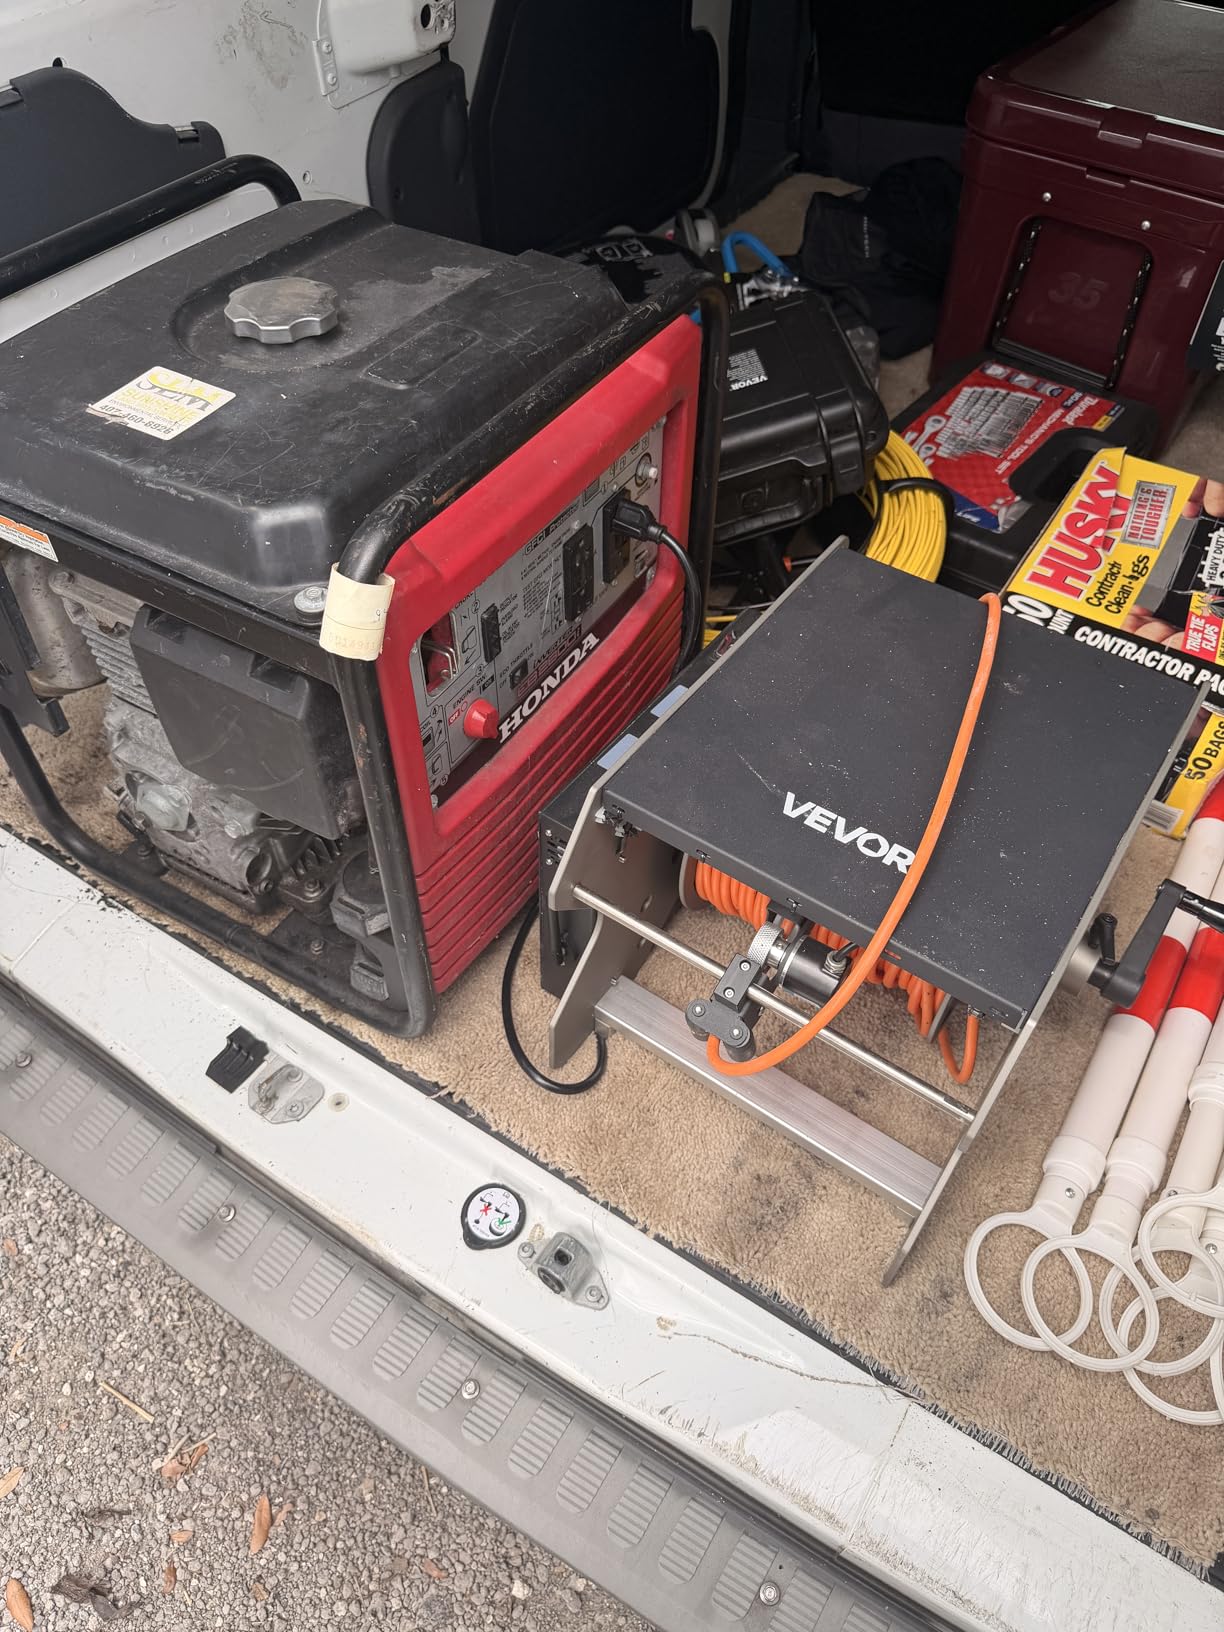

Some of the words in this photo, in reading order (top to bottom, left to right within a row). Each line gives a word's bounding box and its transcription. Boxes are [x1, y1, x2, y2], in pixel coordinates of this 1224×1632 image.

[730, 375, 768, 391] VEVOR
[1025, 463, 1132, 600] HUSKY
[1206, 552, 1221, 582] HEAVY
[1191, 614, 1206, 632] TIE
[1186, 628, 1203, 652] TRUE
[1201, 623, 1220, 651] FLAPS
[1074, 626, 1196, 681] CONTRACTOR
[452, 686, 475, 710] ENGINE
[499, 633, 600, 743] HONDA
[449, 709, 460, 724] OFF
[1185, 756, 1213, 781] 50
[783, 791, 916, 874] VEVOR
